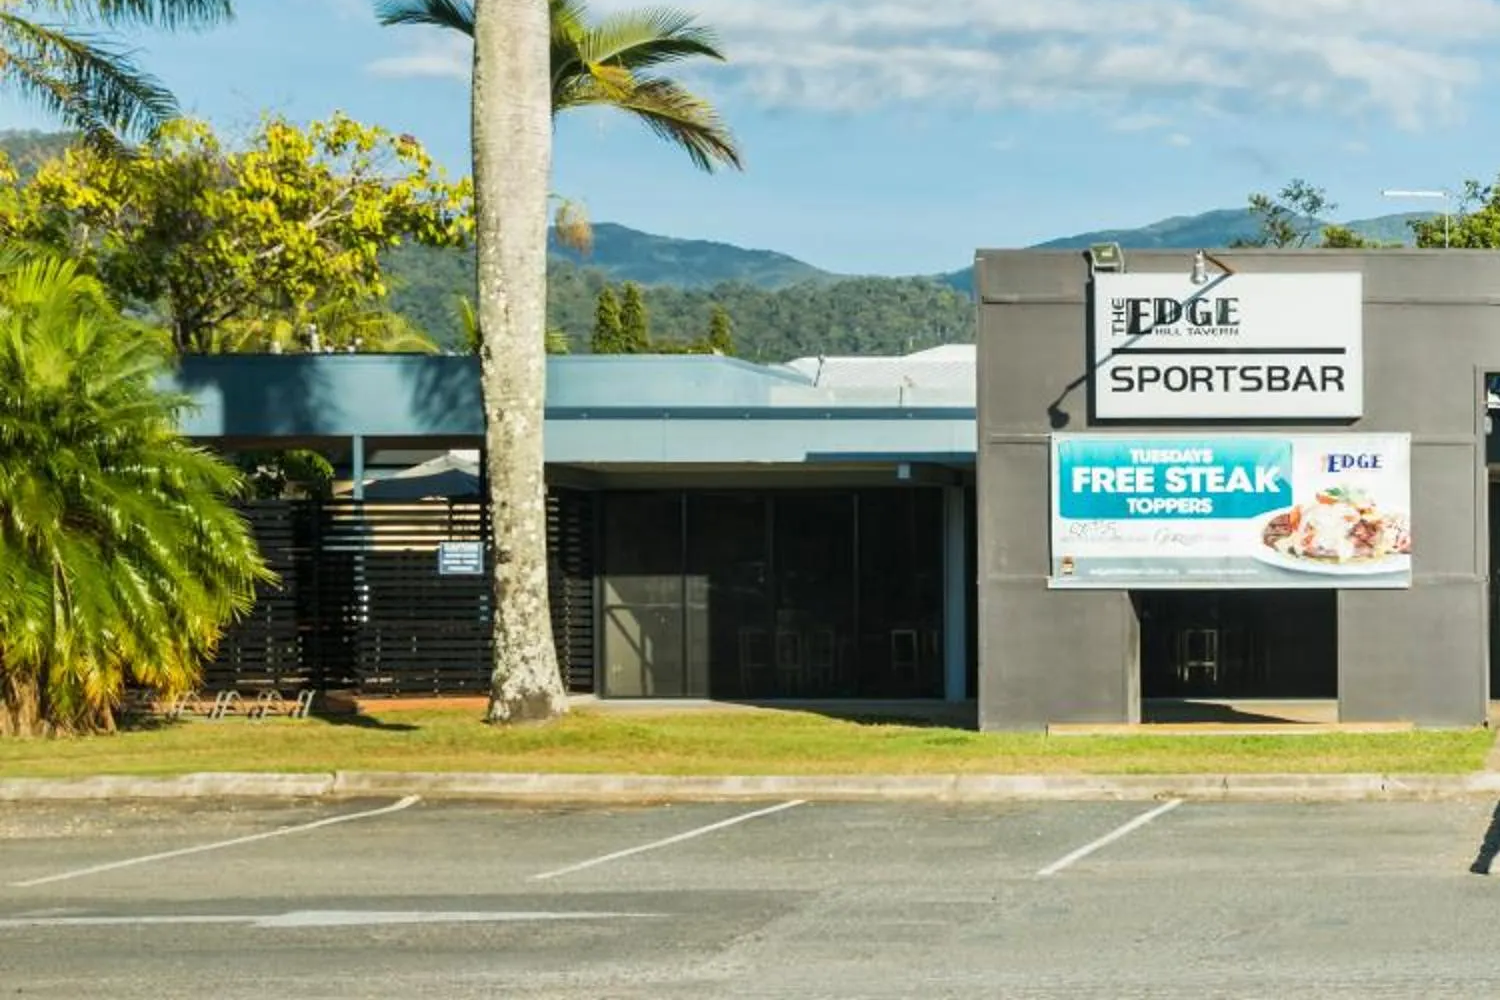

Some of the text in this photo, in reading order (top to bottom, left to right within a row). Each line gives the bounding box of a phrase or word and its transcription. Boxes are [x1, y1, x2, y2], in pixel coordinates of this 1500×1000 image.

[1111, 298, 1125, 336] THE
[1126, 297, 1240, 335] EDGE
[1155, 328, 1240, 336] HILL TAVERN
[1111, 366, 1345, 392] SPORTSBAR
[1130, 448, 1212, 464] TUESDAYS
[1328, 453, 1383, 473] EDGE
[1072, 466, 1282, 493] FREE STEAK
[1127, 497, 1212, 515] TOPPERS
